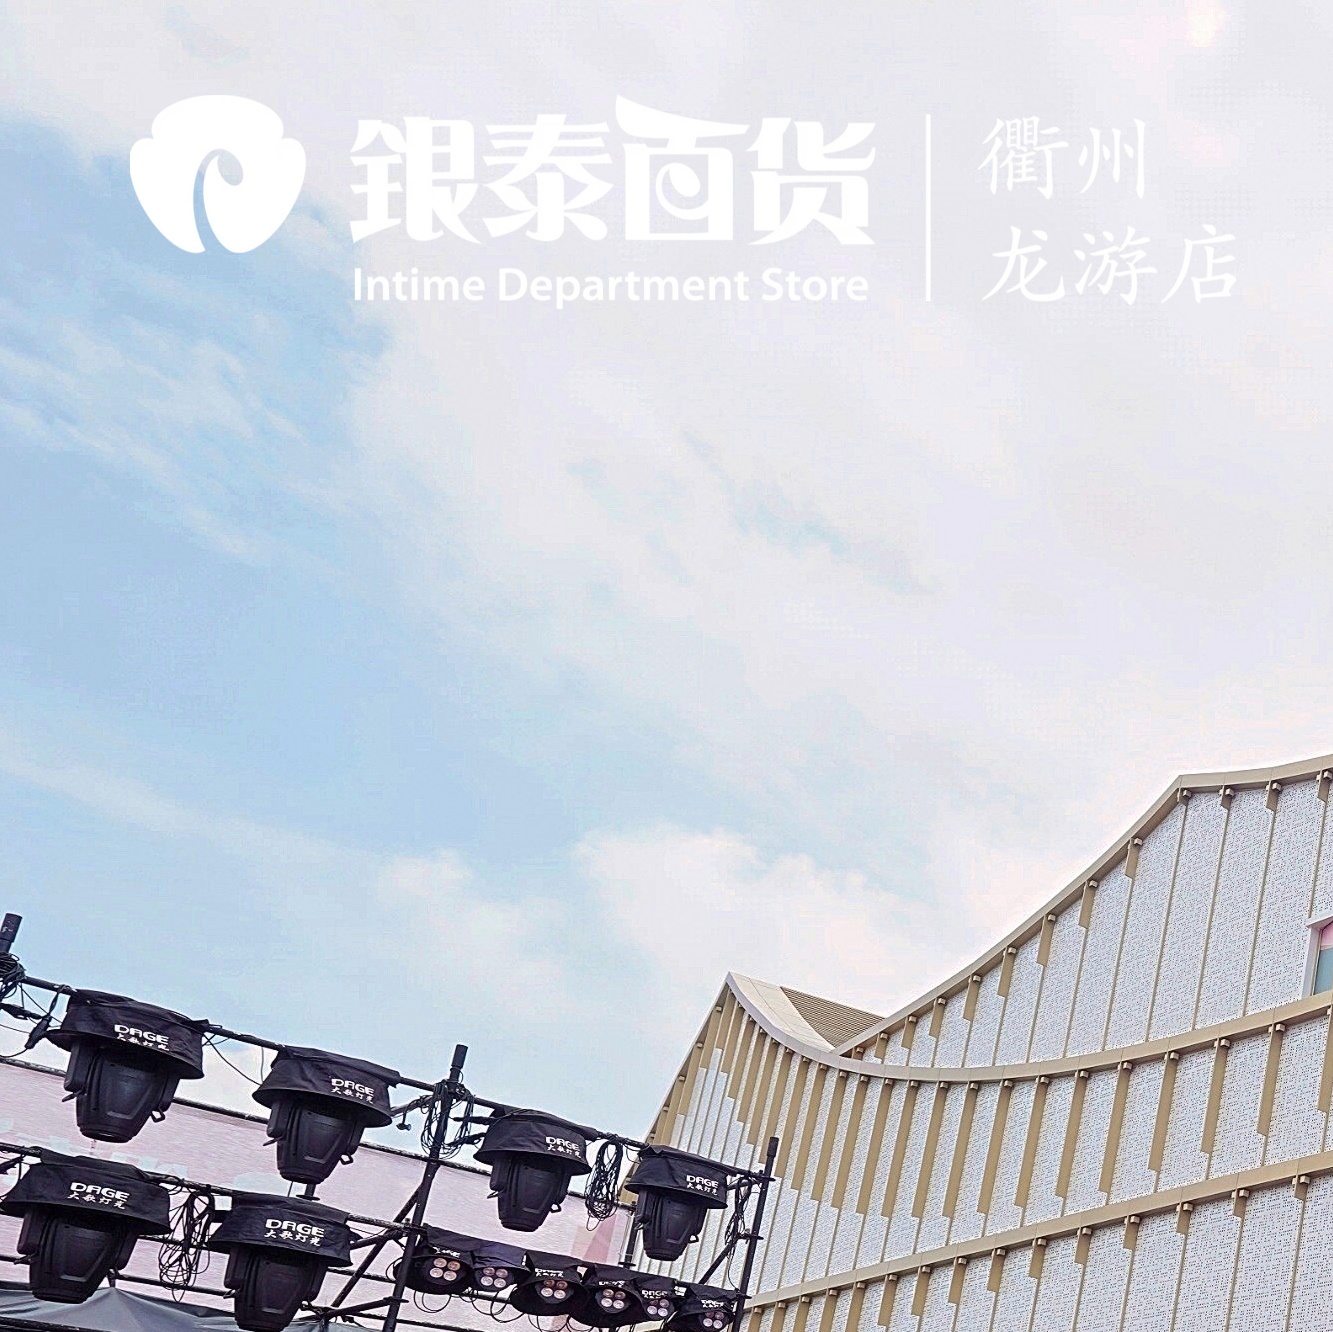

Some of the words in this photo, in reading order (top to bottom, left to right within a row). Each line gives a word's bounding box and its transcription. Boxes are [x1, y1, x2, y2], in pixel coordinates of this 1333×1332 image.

[114, 1024, 169, 1043] DAGE
[331, 1078, 375, 1096] DAGE
[546, 1136, 580, 1151] DAGE
[686, 1174, 719, 1189] DAGE
[70, 1182, 130, 1202] DAGE
[265, 1219, 325, 1238] DAGE
